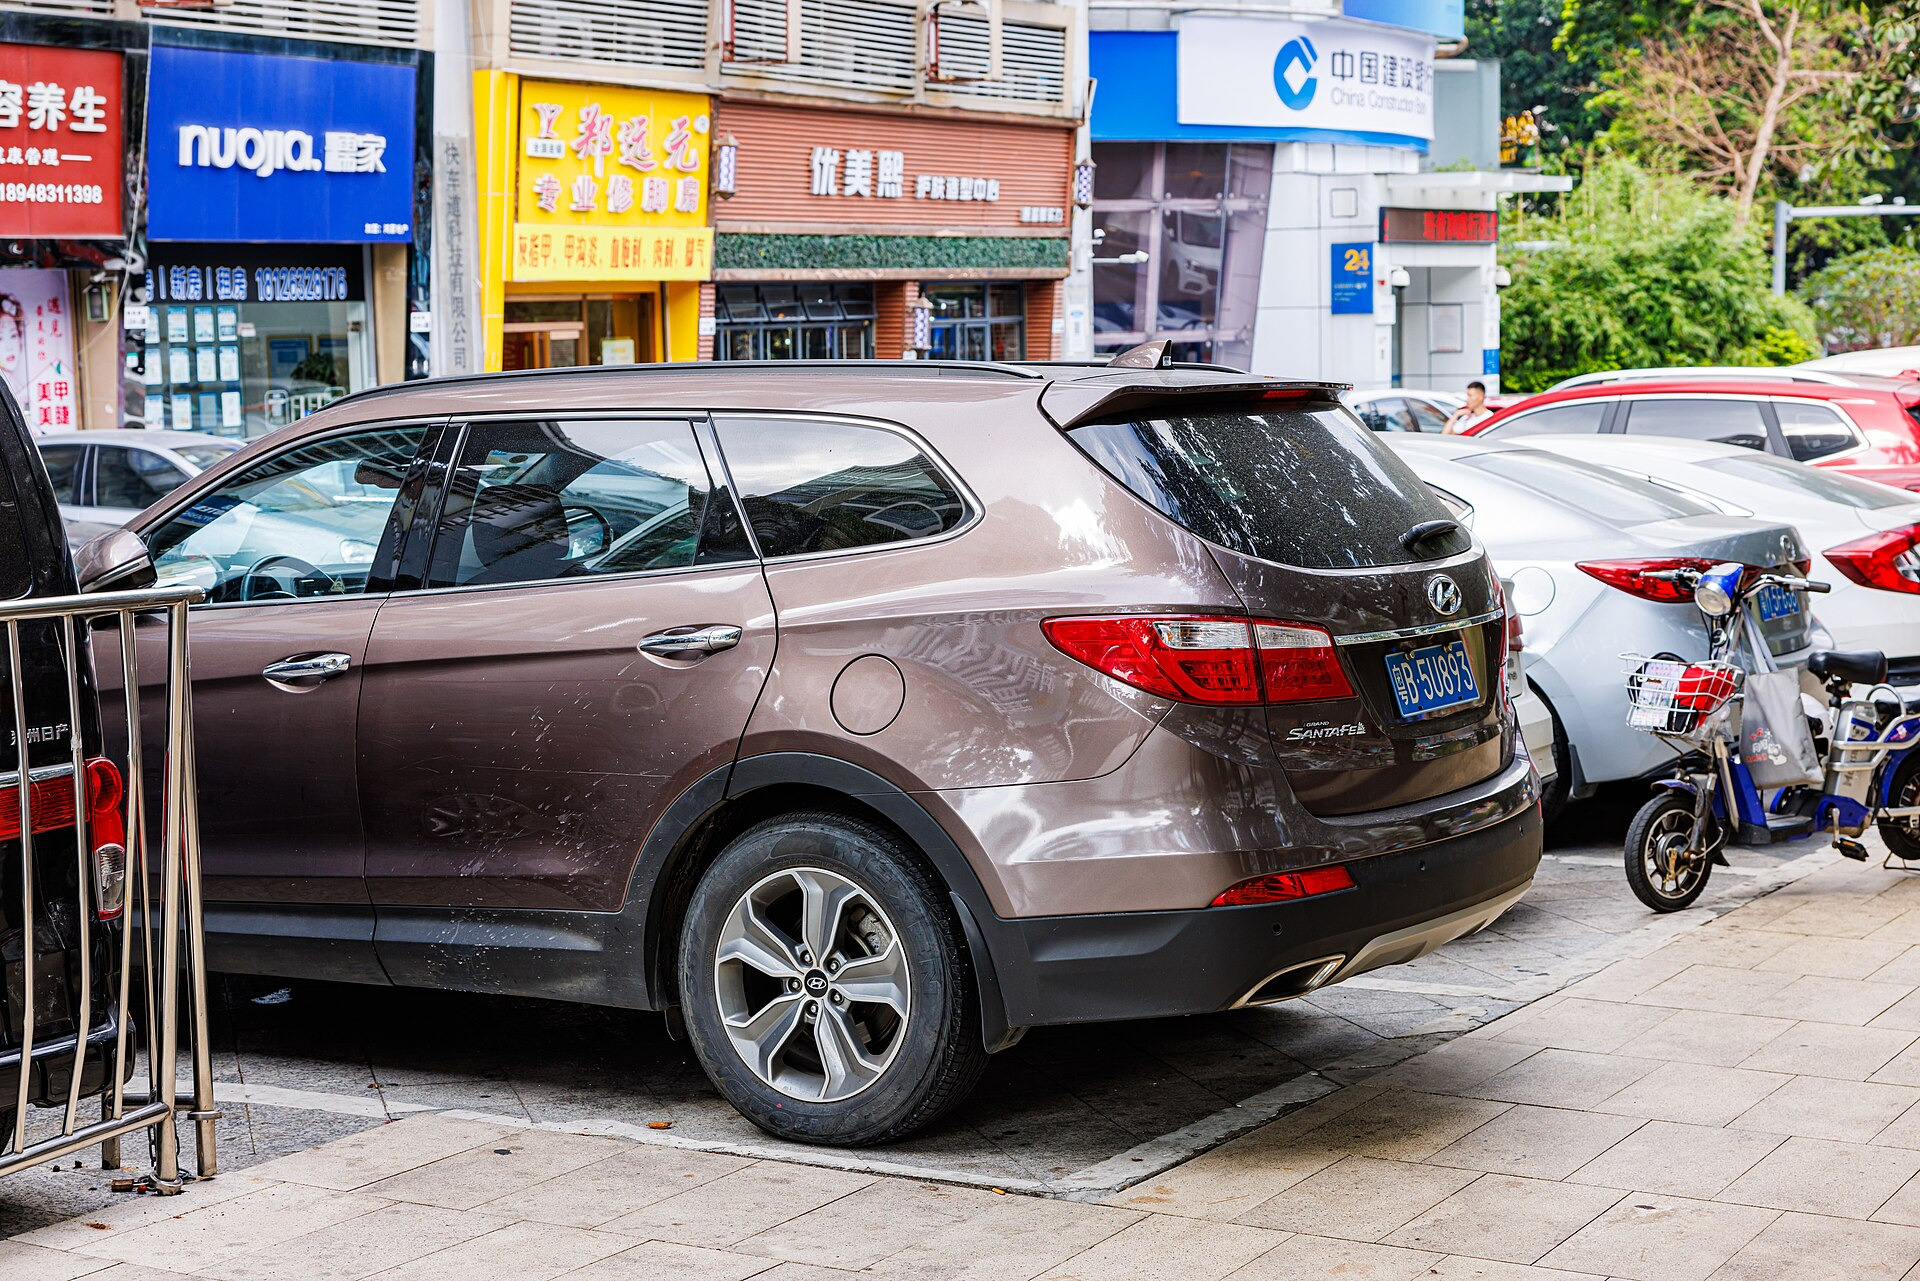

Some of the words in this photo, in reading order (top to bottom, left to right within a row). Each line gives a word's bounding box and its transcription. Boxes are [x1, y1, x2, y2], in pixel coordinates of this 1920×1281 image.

[1331, 49, 1433, 95] 中国建设银行
[1331, 86, 1365, 106] China
[1368, 90, 1414, 112] Construction
[570, 102, 701, 178] 郑远元
[0, 182, 103, 204] 18948311398
[533, 173, 701, 214] 专业修脚房
[1344, 248, 1370, 271] 24
[10, 723, 69, 745] 州日产
